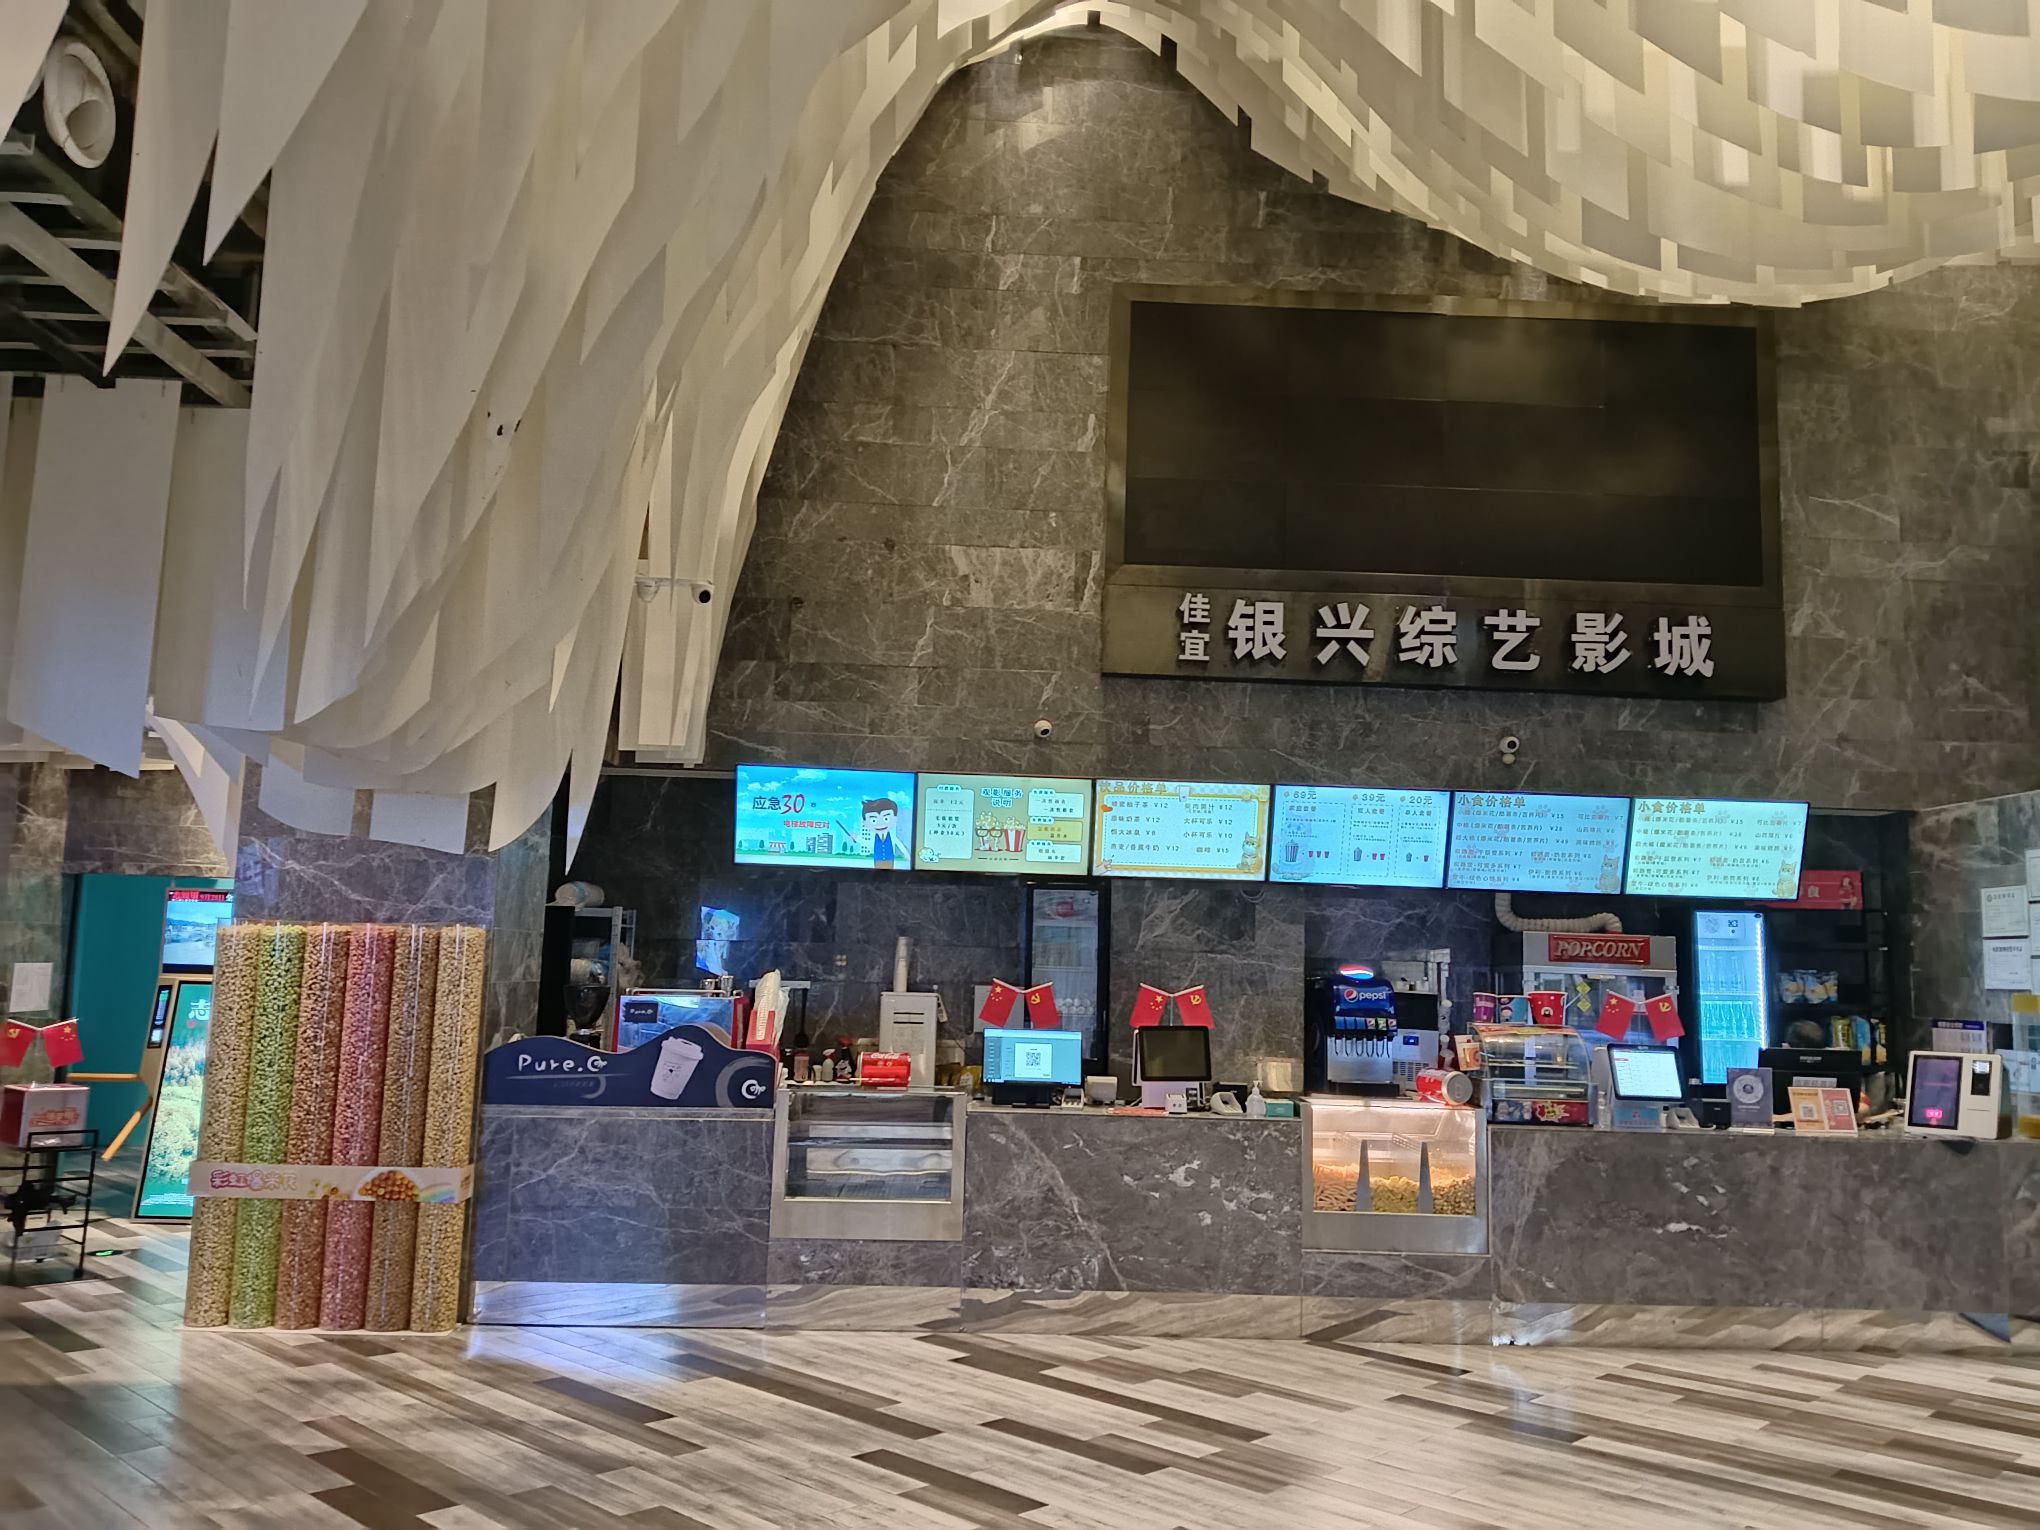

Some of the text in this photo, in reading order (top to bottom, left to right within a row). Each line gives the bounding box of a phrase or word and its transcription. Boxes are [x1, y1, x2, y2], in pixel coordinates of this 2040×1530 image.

[1179, 592, 1211, 663] 佳宜
[1227, 598, 1716, 679] 银兴综艺影城
[1294, 790, 1316, 800] 69元
[1362, 794, 1386, 802] 39元
[1409, 796, 1432, 804] 20元
[1457, 794, 1526, 808] 小食价格单
[1638, 801, 1706, 814] 小食价格单
[1555, 940, 1643, 958] POPCORN
[1359, 992, 1386, 1001] pepsi
